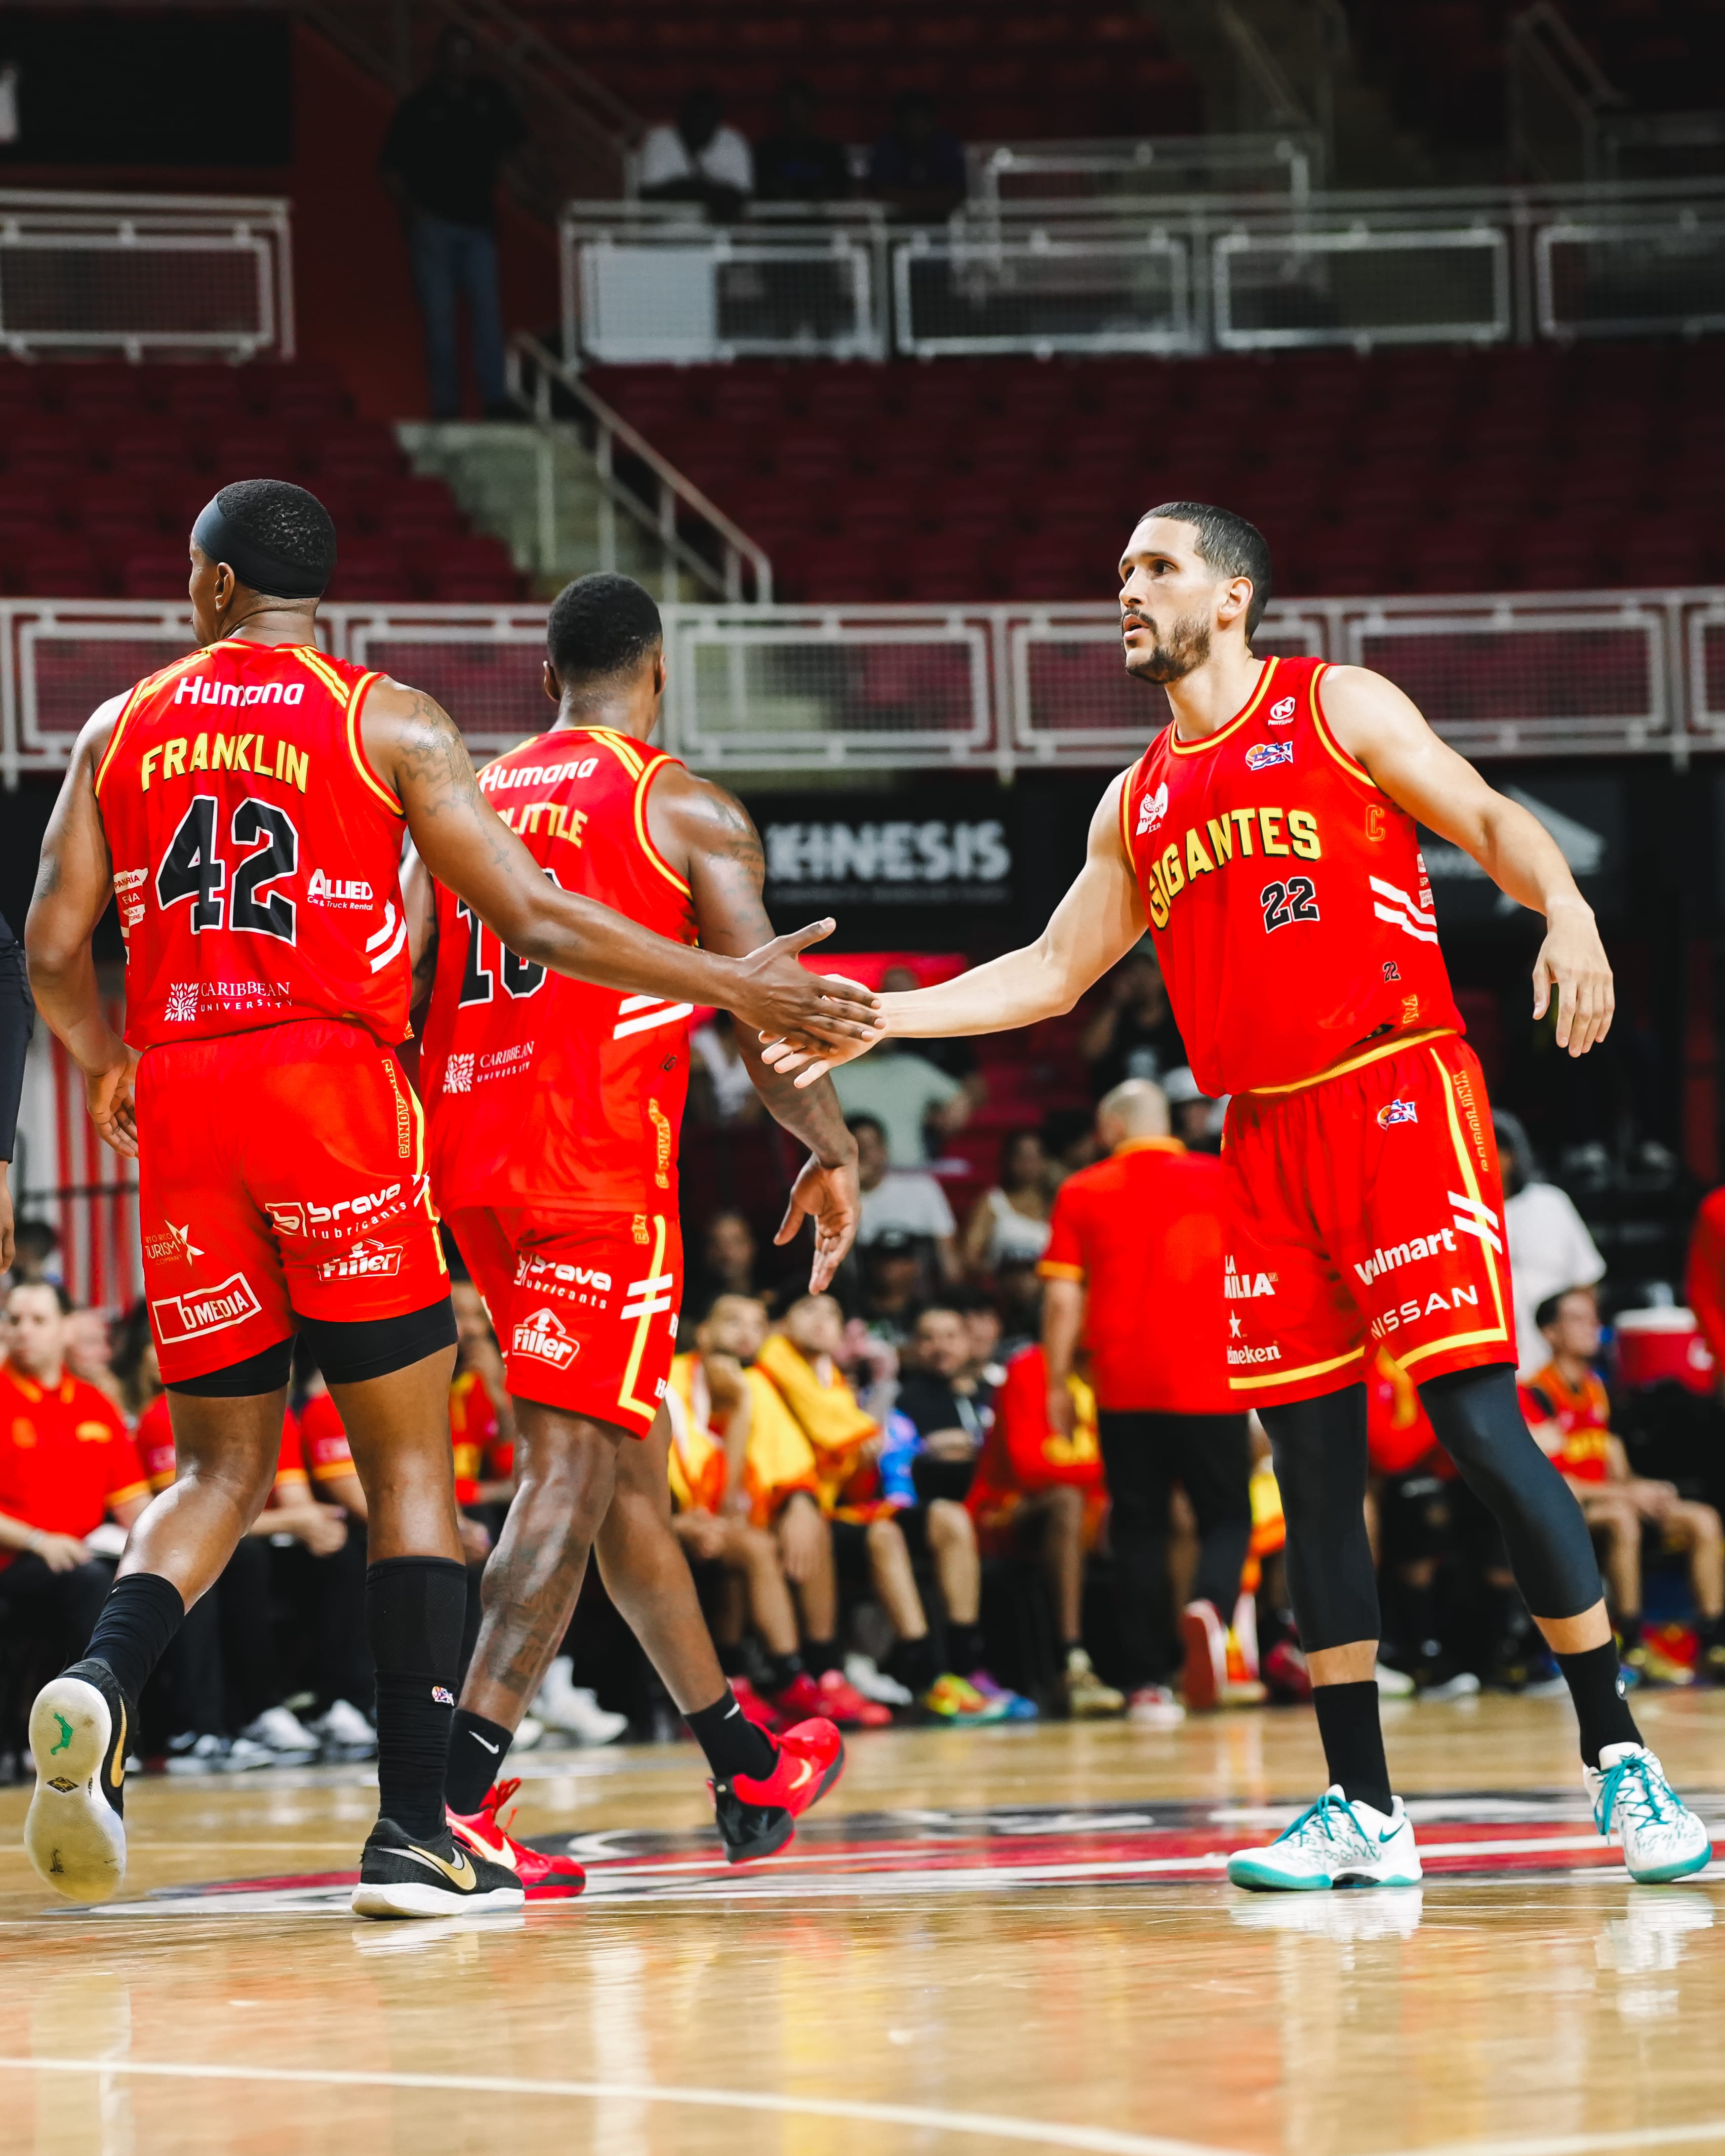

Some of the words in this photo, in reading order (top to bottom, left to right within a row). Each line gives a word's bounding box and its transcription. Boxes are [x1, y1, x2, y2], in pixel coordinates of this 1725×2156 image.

[174, 676, 304, 706] Humana
[141, 732, 309, 794] FRANKLIN
[479, 758, 599, 794] Humana
[764, 819, 1011, 881] KINESIS
[155, 794, 299, 947] 42
[307, 868, 373, 900] ALLIED
[1149, 807, 1322, 931] GIGANTES
[307, 896, 318, 905] Ca
[327, 901, 348, 909] Truck
[349, 902, 373, 910] Rental
[1260, 876, 1320, 934] 22
[1382, 961, 1401, 984] 22
[201, 981, 291, 997] CARIBBEAN
[200, 999, 293, 1012] UNIVERSITY
[480, 1040, 535, 1069] CARIBBEAN
[476, 1061, 531, 1083] UNIVERSITY
[307, 1184, 401, 1223] brava
[312, 1202, 407, 1239] lubricants
[145, 1240, 180, 1259] TURISM
[156, 1254, 183, 1266] COMPANY
[1353, 1228, 1457, 1286] Wlmart
[1371, 1285, 1478, 1340] NISSAN
[514, 1328, 573, 1361] Filler
[1227, 1345, 1282, 1365] eineken
